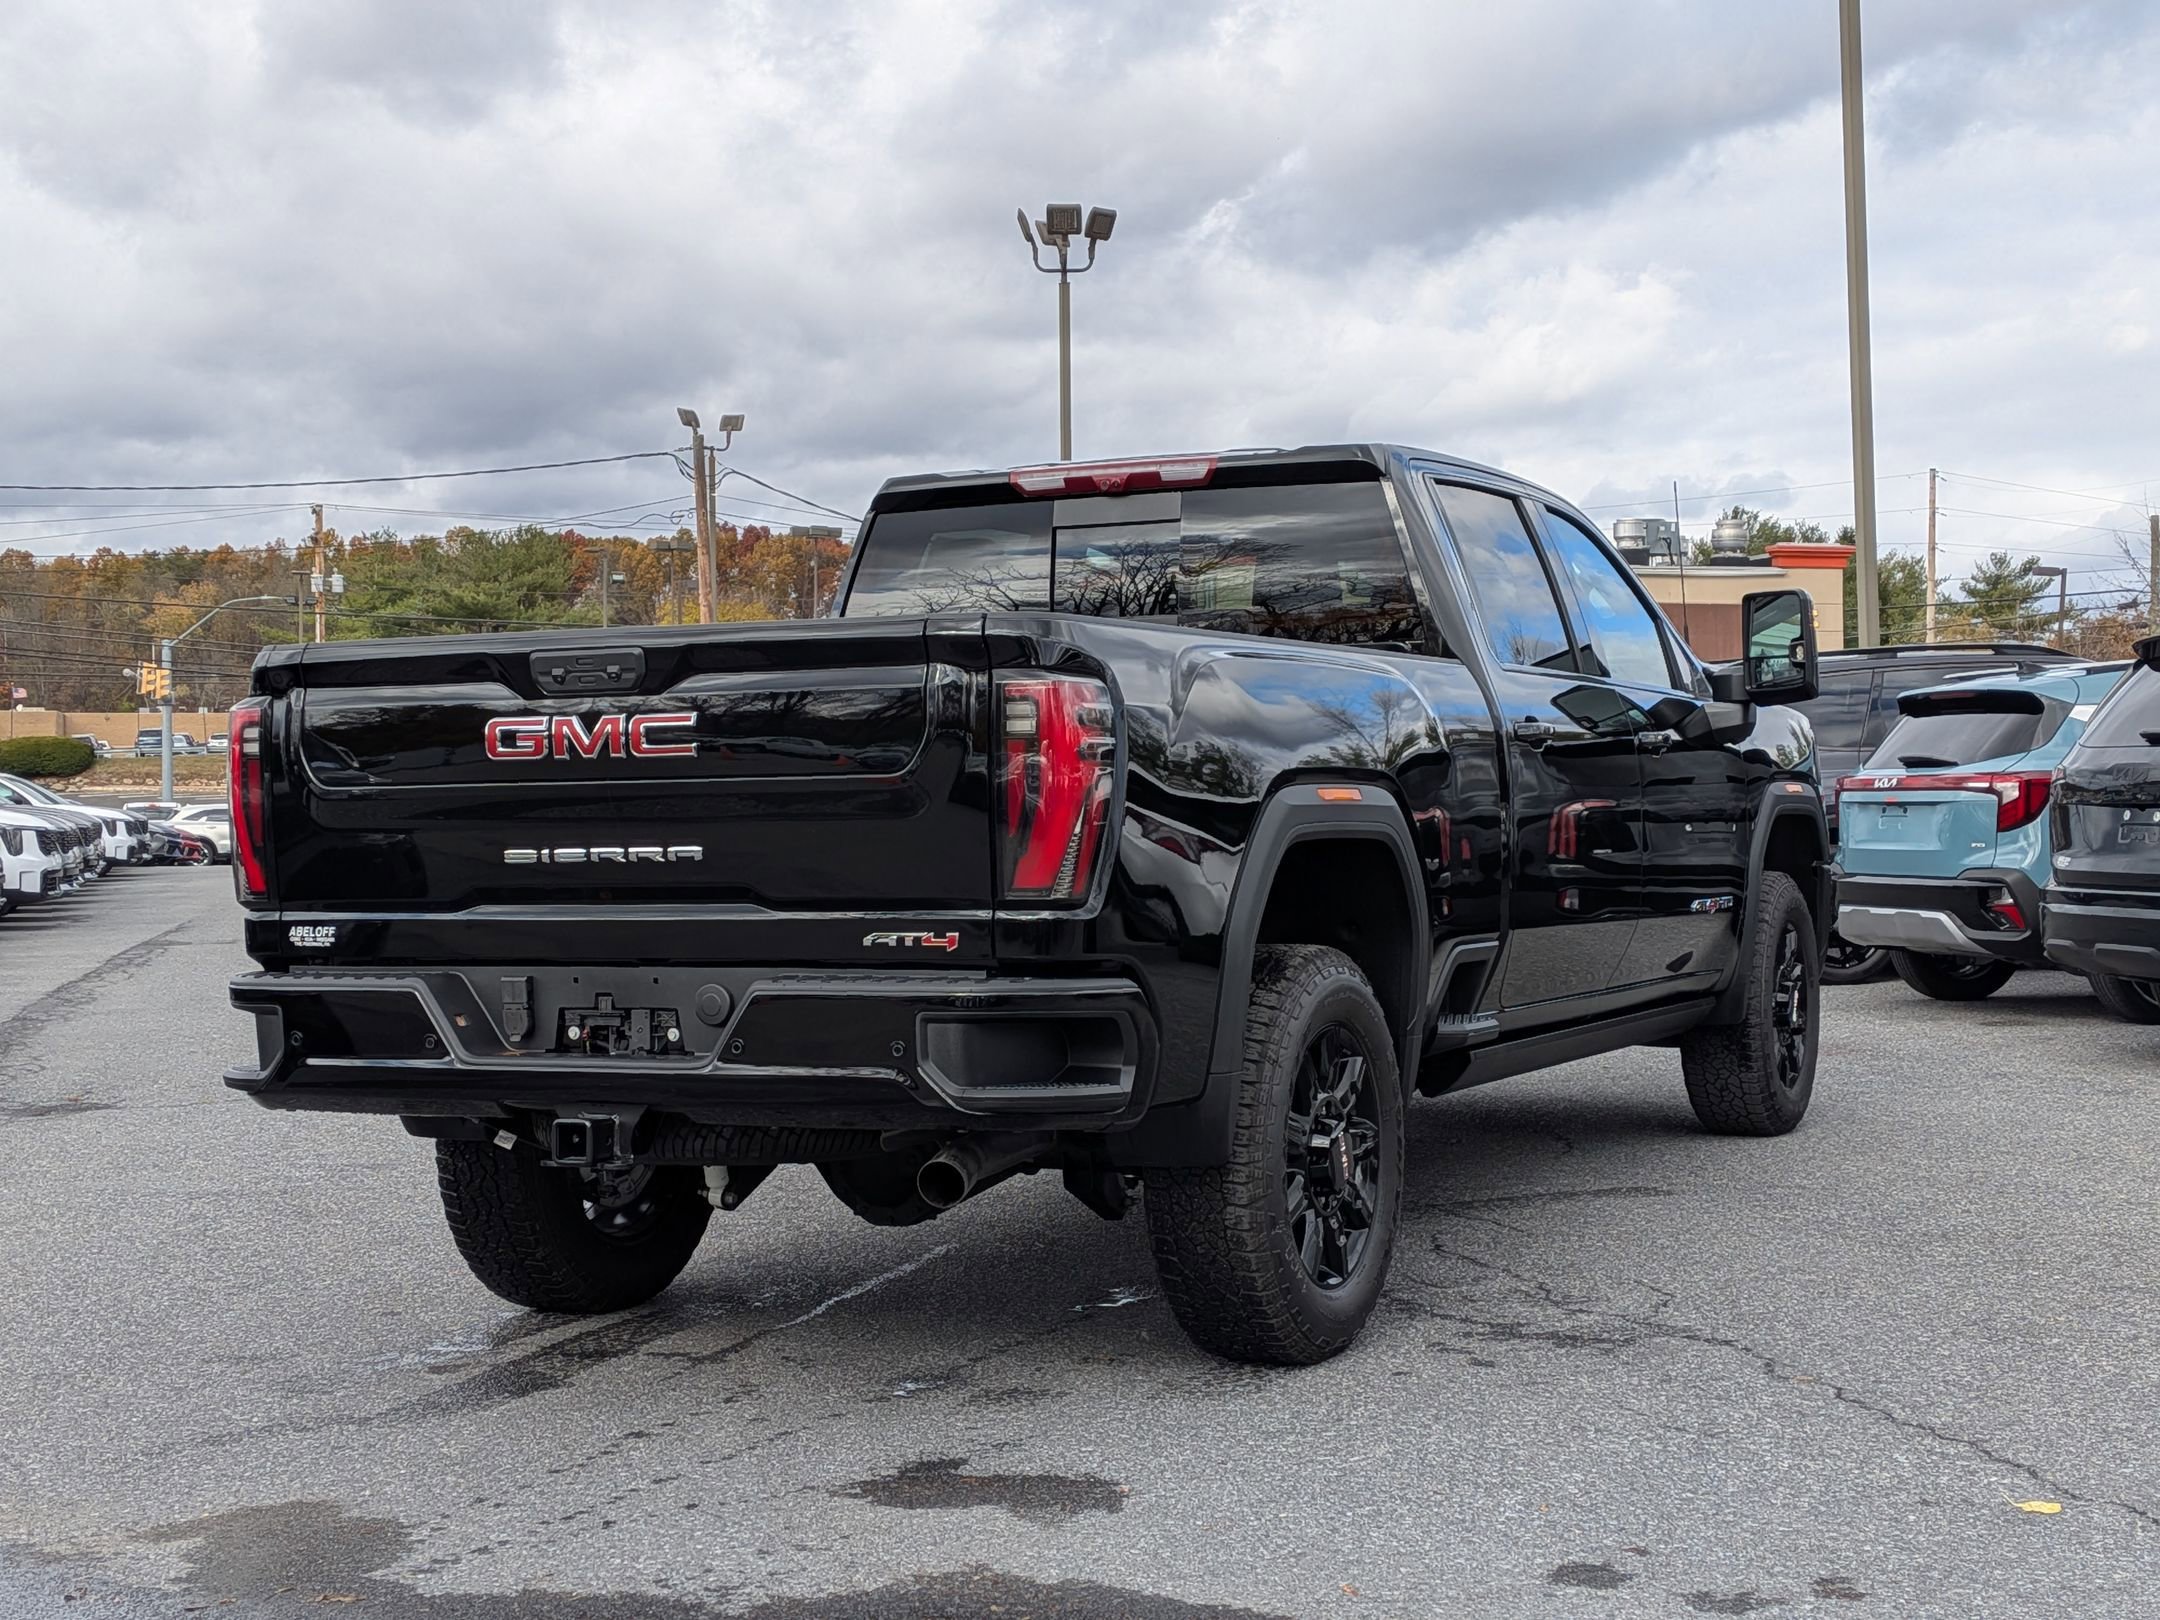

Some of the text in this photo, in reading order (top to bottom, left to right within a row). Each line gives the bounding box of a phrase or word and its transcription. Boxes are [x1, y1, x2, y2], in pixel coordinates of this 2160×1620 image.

[485, 712, 699, 760] GMC
[1874, 777, 1898, 788] KIA
[504, 845, 703, 863] SIERRA
[288, 925, 336, 937] ABELOFF
[863, 931, 960, 952] AT4
